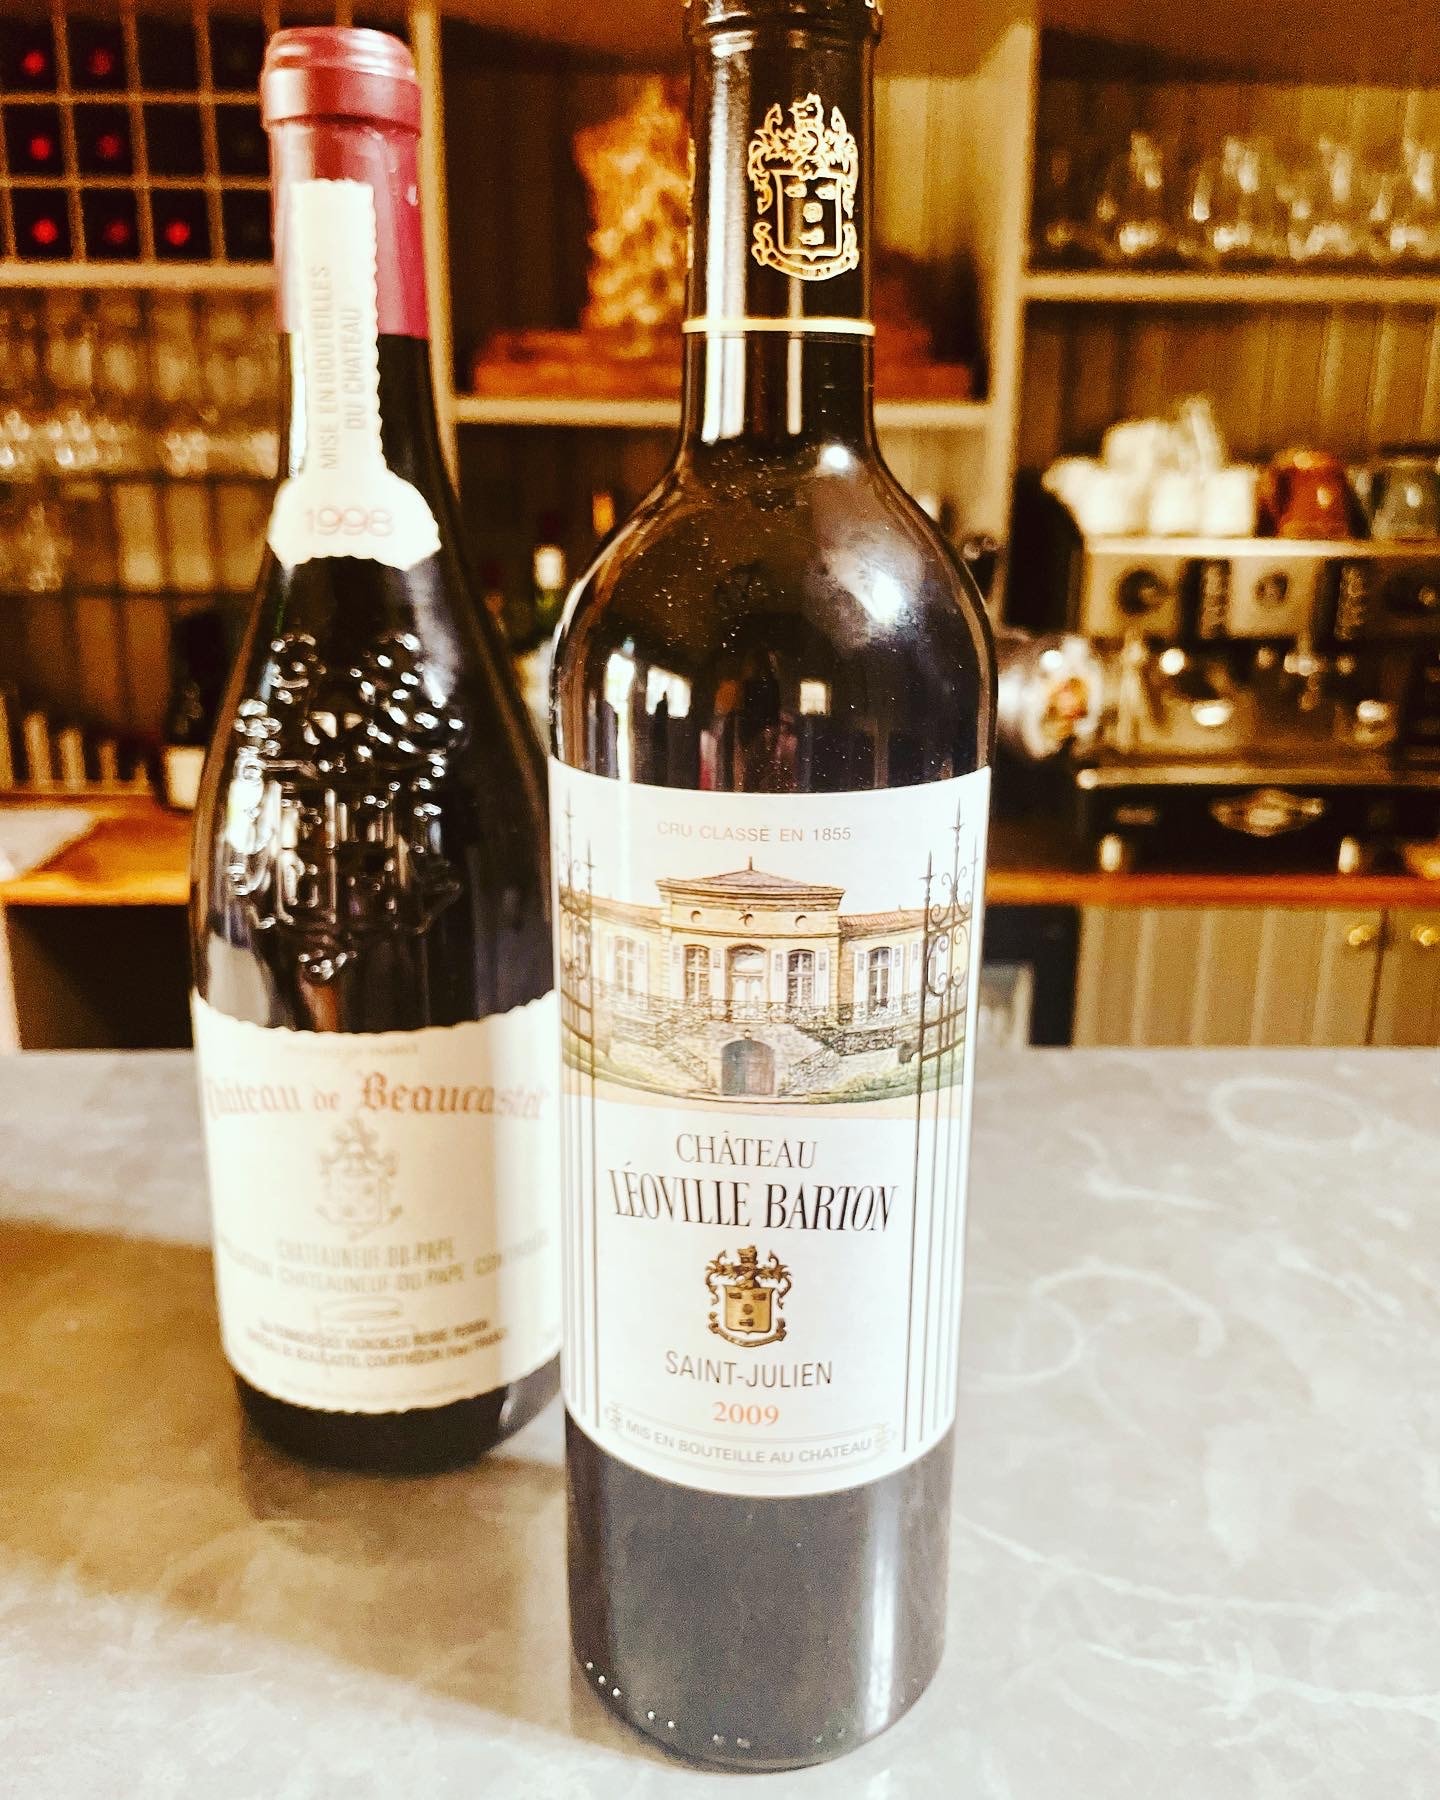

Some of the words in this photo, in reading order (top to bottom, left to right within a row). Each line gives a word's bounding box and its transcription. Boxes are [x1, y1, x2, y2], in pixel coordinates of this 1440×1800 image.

[310, 264, 337, 384] BOUTEILLES
[317, 391, 338, 415] EN
[345, 402, 367, 430] DU
[319, 423, 340, 470] MISE
[304, 504, 394, 537] 1998
[656, 820, 693, 838] CRU
[779, 827, 804, 842] EN
[812, 827, 852, 842] 1855
[675, 1130, 818, 1169] CHÂTEAU
[607, 1160, 751, 1228] LÉOVILLE
[762, 1182, 900, 1232] BARTON
[665, 1350, 833, 1388] SAINT-JULIEN
[712, 1401, 779, 1427] 2009
[625, 1419, 651, 1441] MIS
[654, 1431, 674, 1449] EN
[678, 1438, 769, 1464] BOUTEILLE
[770, 1446, 795, 1464] AU
